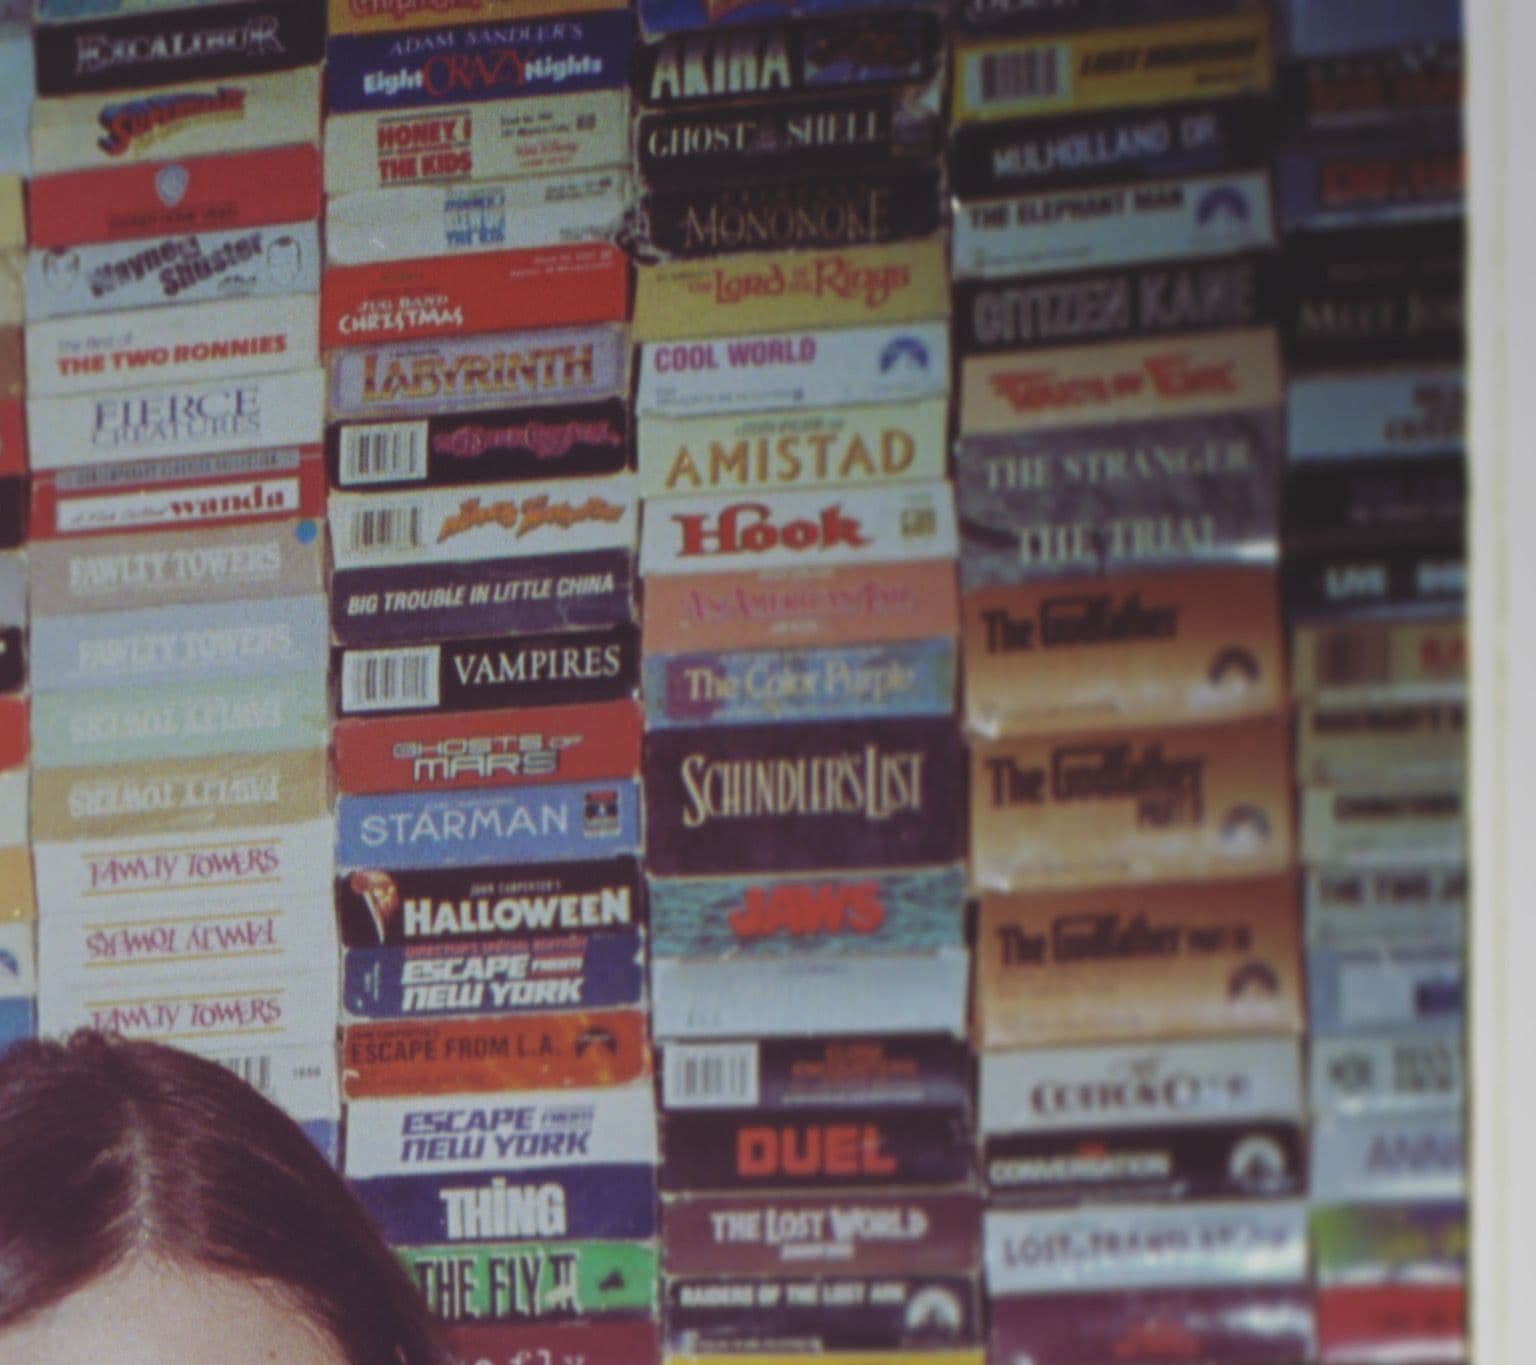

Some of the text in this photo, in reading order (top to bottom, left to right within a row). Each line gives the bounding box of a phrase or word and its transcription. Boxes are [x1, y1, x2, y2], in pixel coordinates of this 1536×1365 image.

[76, 17, 284, 77] EXCALIBUR
[390, 36, 456, 56] ADAM
[364, 68, 423, 96] Eight
[524, 54, 603, 81] Nights
[649, 110, 884, 158] GHOST SHELL
[378, 151, 472, 182] THE KIDS
[337, 304, 465, 335] CHRISTMAS
[973, 273, 1129, 345] CITIZEN
[57, 333, 288, 377] THE TWO RONNIES
[358, 342, 595, 401] LABYRINTH
[654, 336, 817, 373] COOL WORLD
[95, 384, 263, 433] FIERCE
[665, 424, 917, 488] AMISTAD
[670, 502, 875, 558] Hook
[68, 540, 281, 597] FAWLTY TOWERS
[347, 572, 615, 615] BIG TROUBLE IN LITTLE CHINA
[181, 623, 291, 664] TOWERS
[980, 606, 1034, 654] The
[453, 644, 623, 687] VAMPIRES
[683, 666, 739, 702] The
[392, 733, 544, 759] GHOSTS
[413, 749, 558, 783] MARS
[67, 777, 179, 819] TOWERS
[681, 745, 927, 829] SCHINDLER'S LIST
[983, 755, 1047, 809] The
[359, 802, 570, 848] STARMAN
[186, 845, 280, 879] TOWERS
[403, 885, 632, 937] HALLOWEEN
[728, 879, 886, 937] JAWS
[84, 925, 177, 960] TOWERS
[996, 922, 1047, 967] The
[401, 953, 531, 986] ESCAPE
[189, 997, 282, 1029] TOWERS
[401, 976, 585, 1012] NEW YORK
[350, 1038, 434, 1066] ESCAPE
[445, 1034, 510, 1061] FROM
[400, 1106, 536, 1135] ESCAPE
[400, 1129, 592, 1163] NEW YORK
[736, 1125, 897, 1178] DUEL
[438, 1175, 568, 1241] THING
[710, 1203, 931, 1247] THE LOST WORLD
[416, 1254, 481, 1321] THE
[487, 1248, 547, 1319] FLY
